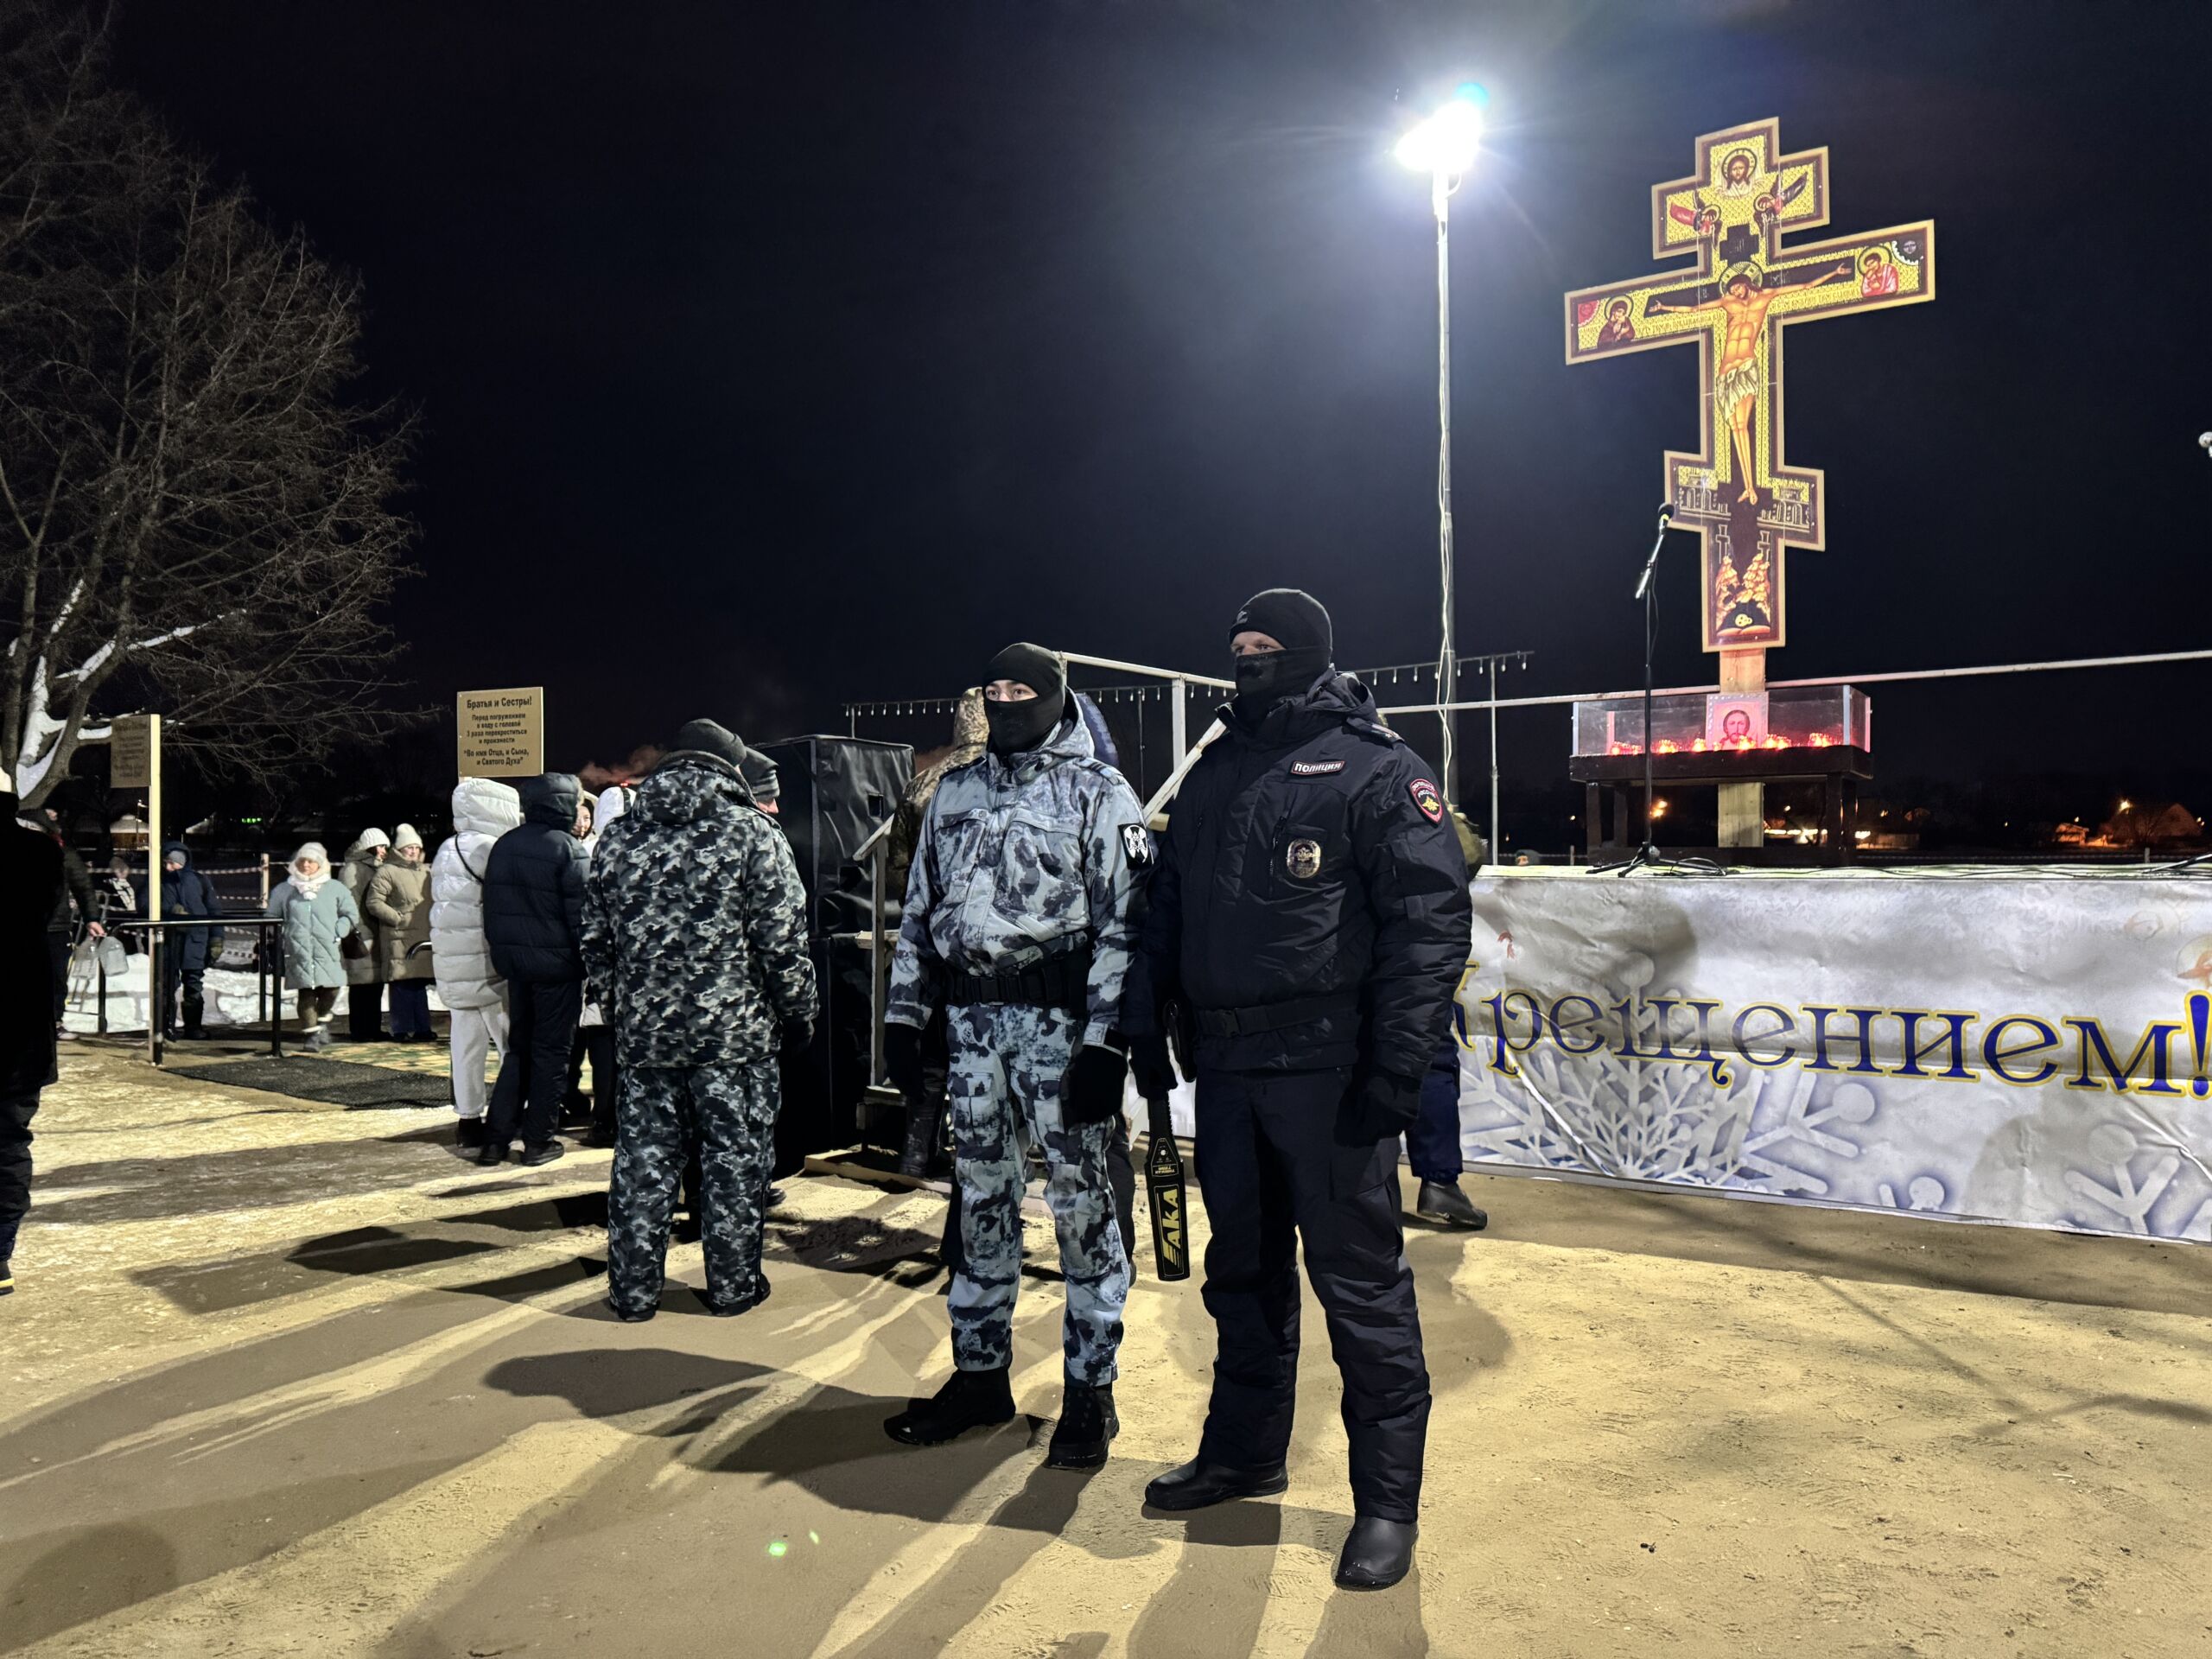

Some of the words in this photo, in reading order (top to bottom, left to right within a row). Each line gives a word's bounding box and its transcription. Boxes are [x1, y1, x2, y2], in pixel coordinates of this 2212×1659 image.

[467, 699, 492, 710] Братья
[501, 696, 532, 708] Сестры!
[1294, 762, 1342, 773] ПОЛИЦИЯ
